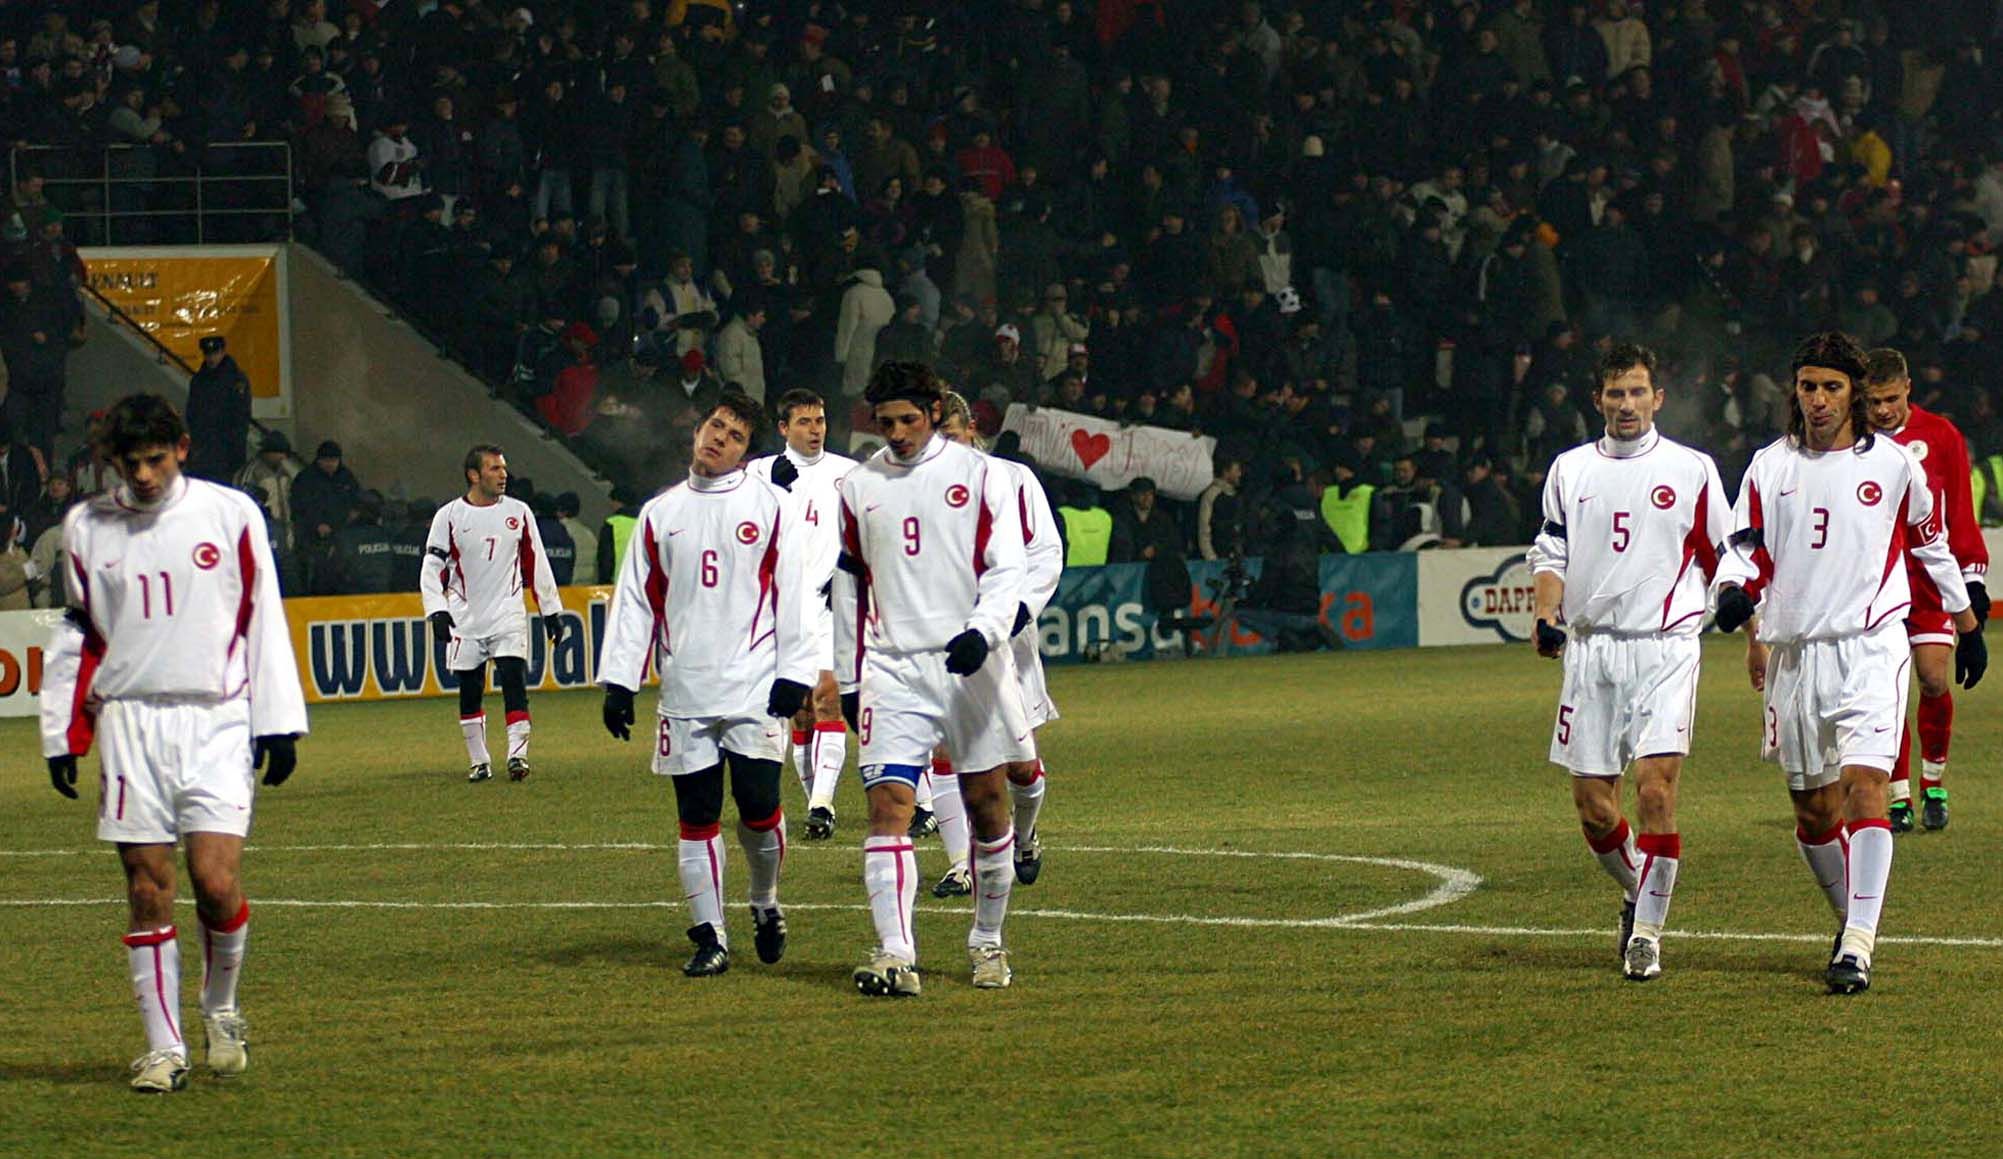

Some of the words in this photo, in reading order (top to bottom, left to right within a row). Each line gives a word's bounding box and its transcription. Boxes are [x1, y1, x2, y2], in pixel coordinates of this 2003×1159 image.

[805, 499, 819, 527] 4
[1612, 512, 1630, 553] 5
[1812, 508, 1829, 550] 3
[485, 538, 496, 561] 7
[903, 516, 921, 556] 9
[702, 550, 718, 588] 6
[138, 571, 173, 619] 11
[453, 636, 462, 660] 7
[659, 719, 671, 757] 6
[861, 707, 873, 746] 9
[1557, 706, 1574, 745] 5
[1769, 706, 1777, 748] 3
